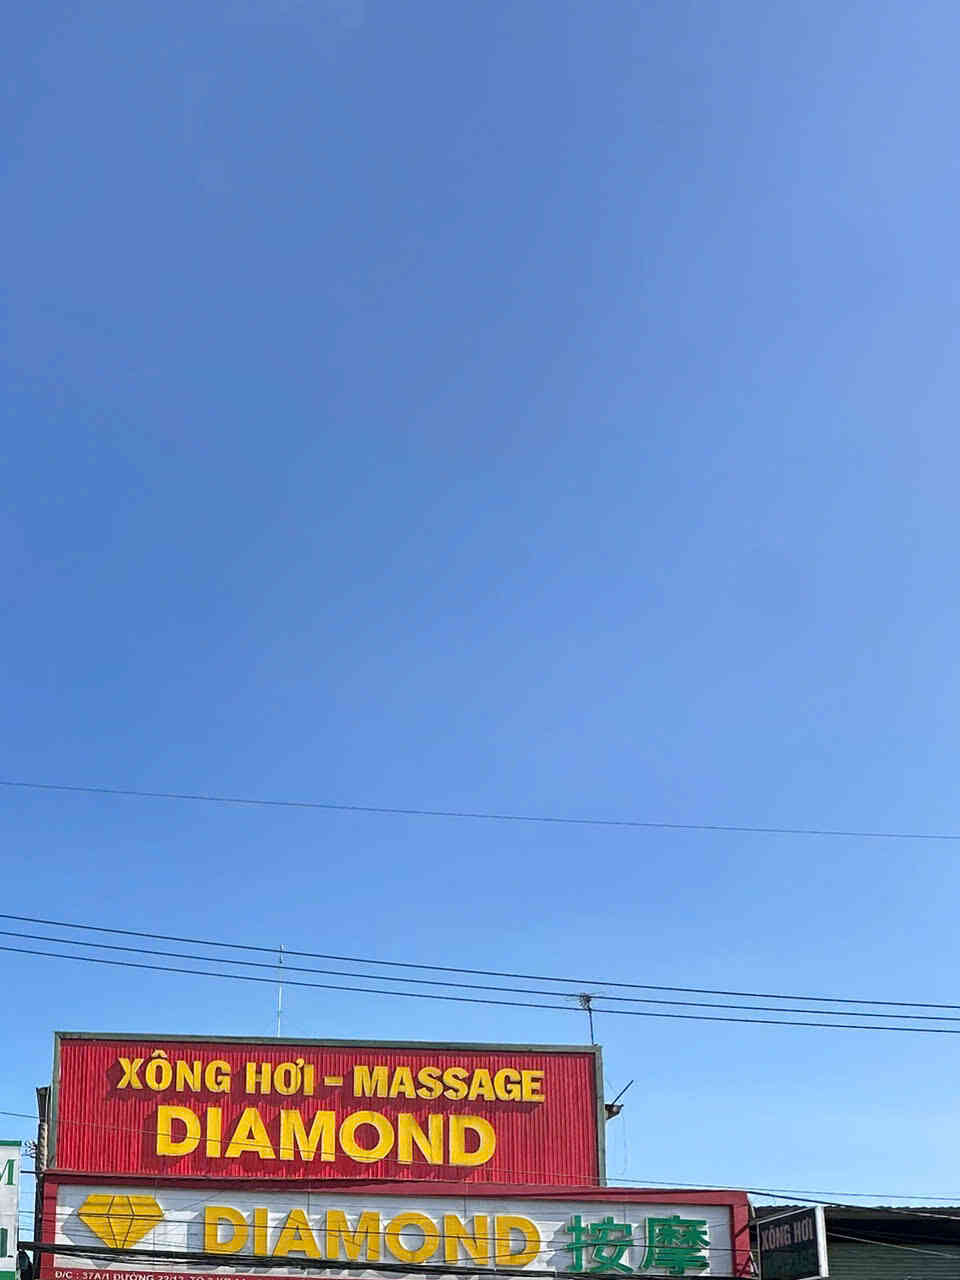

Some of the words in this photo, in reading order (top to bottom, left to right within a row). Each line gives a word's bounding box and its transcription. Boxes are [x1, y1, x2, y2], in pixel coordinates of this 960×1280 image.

[116, 1050, 231, 1093] XÔNG
[245, 1057, 314, 1096] HƠI
[353, 1065, 545, 1102] MASSAGE
[156, 1105, 497, 1167] DIAMOND
[203, 1205, 542, 1266] DIAMOND
[564, 1215, 711, 1275] 按摩
[761, 1224, 791, 1250] XÔNG
